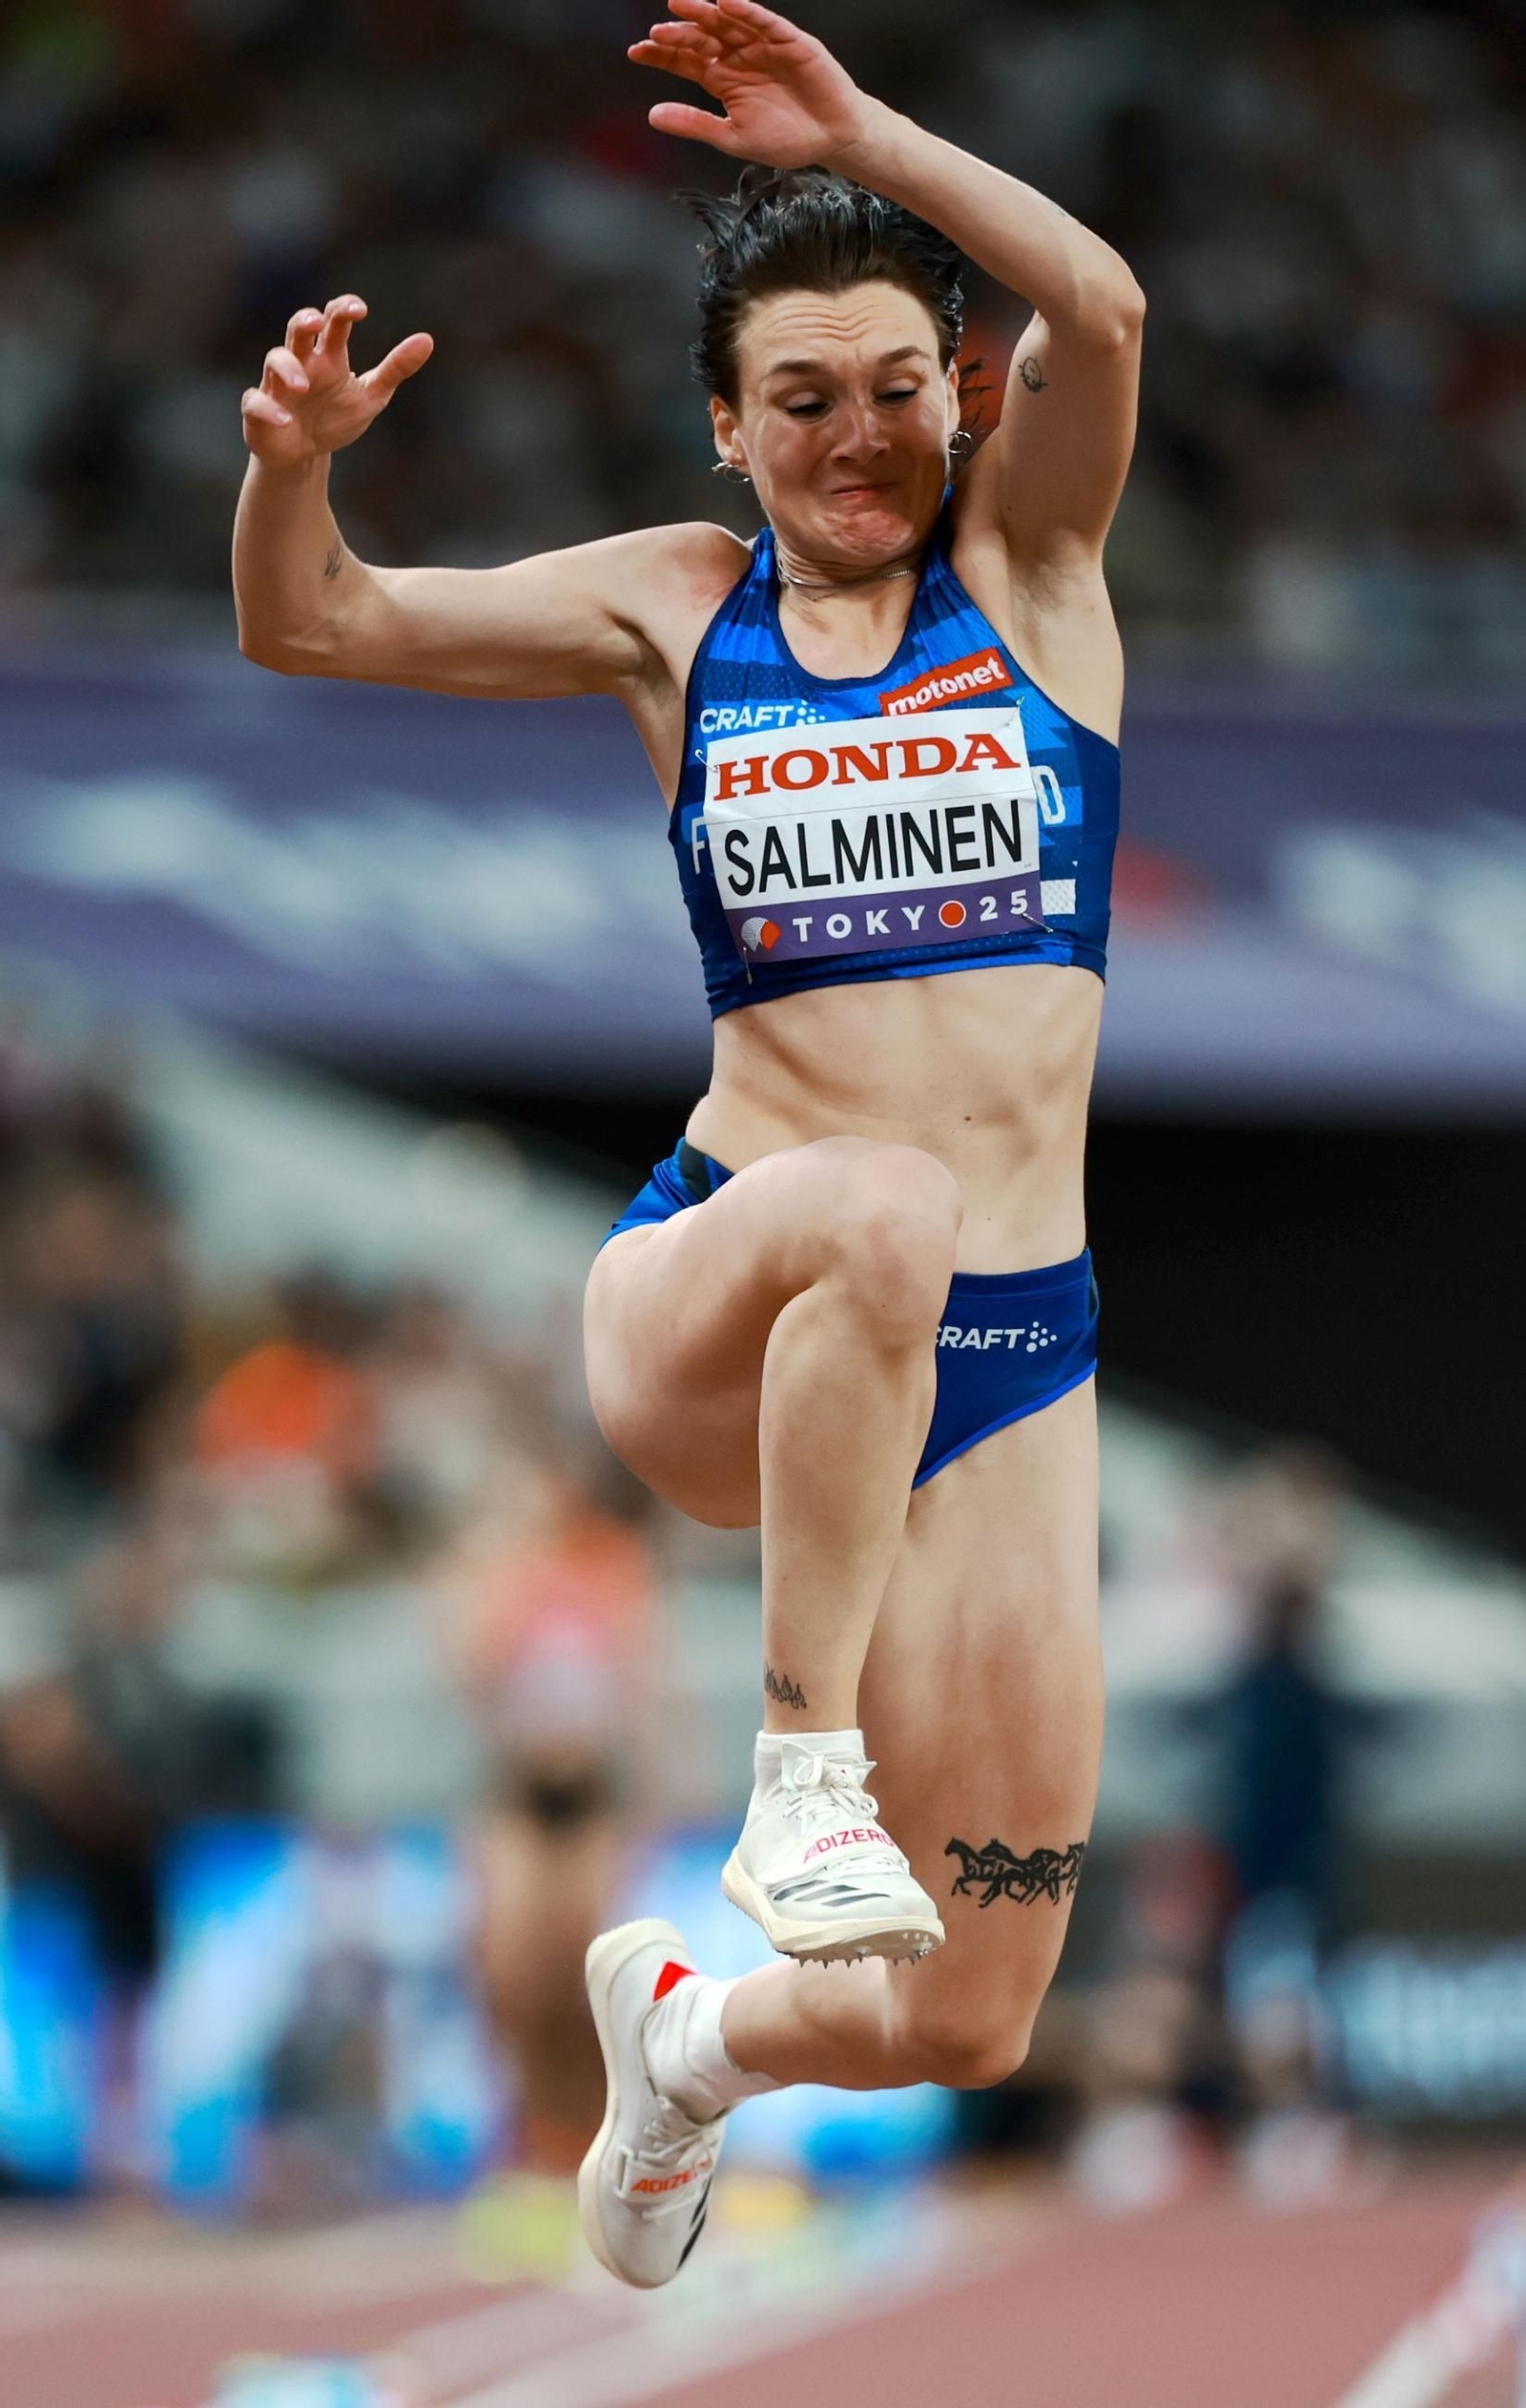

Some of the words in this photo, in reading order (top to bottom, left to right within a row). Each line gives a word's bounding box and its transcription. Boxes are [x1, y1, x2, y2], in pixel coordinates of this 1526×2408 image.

[888, 656, 1005, 716] motonet
[700, 704, 794, 734] CRAFT
[714, 734, 1021, 800] HONDA
[724, 799, 1023, 897] SALMINEN
[979, 889, 1029, 922] 25
[936, 1325, 1025, 1350] RAFT
